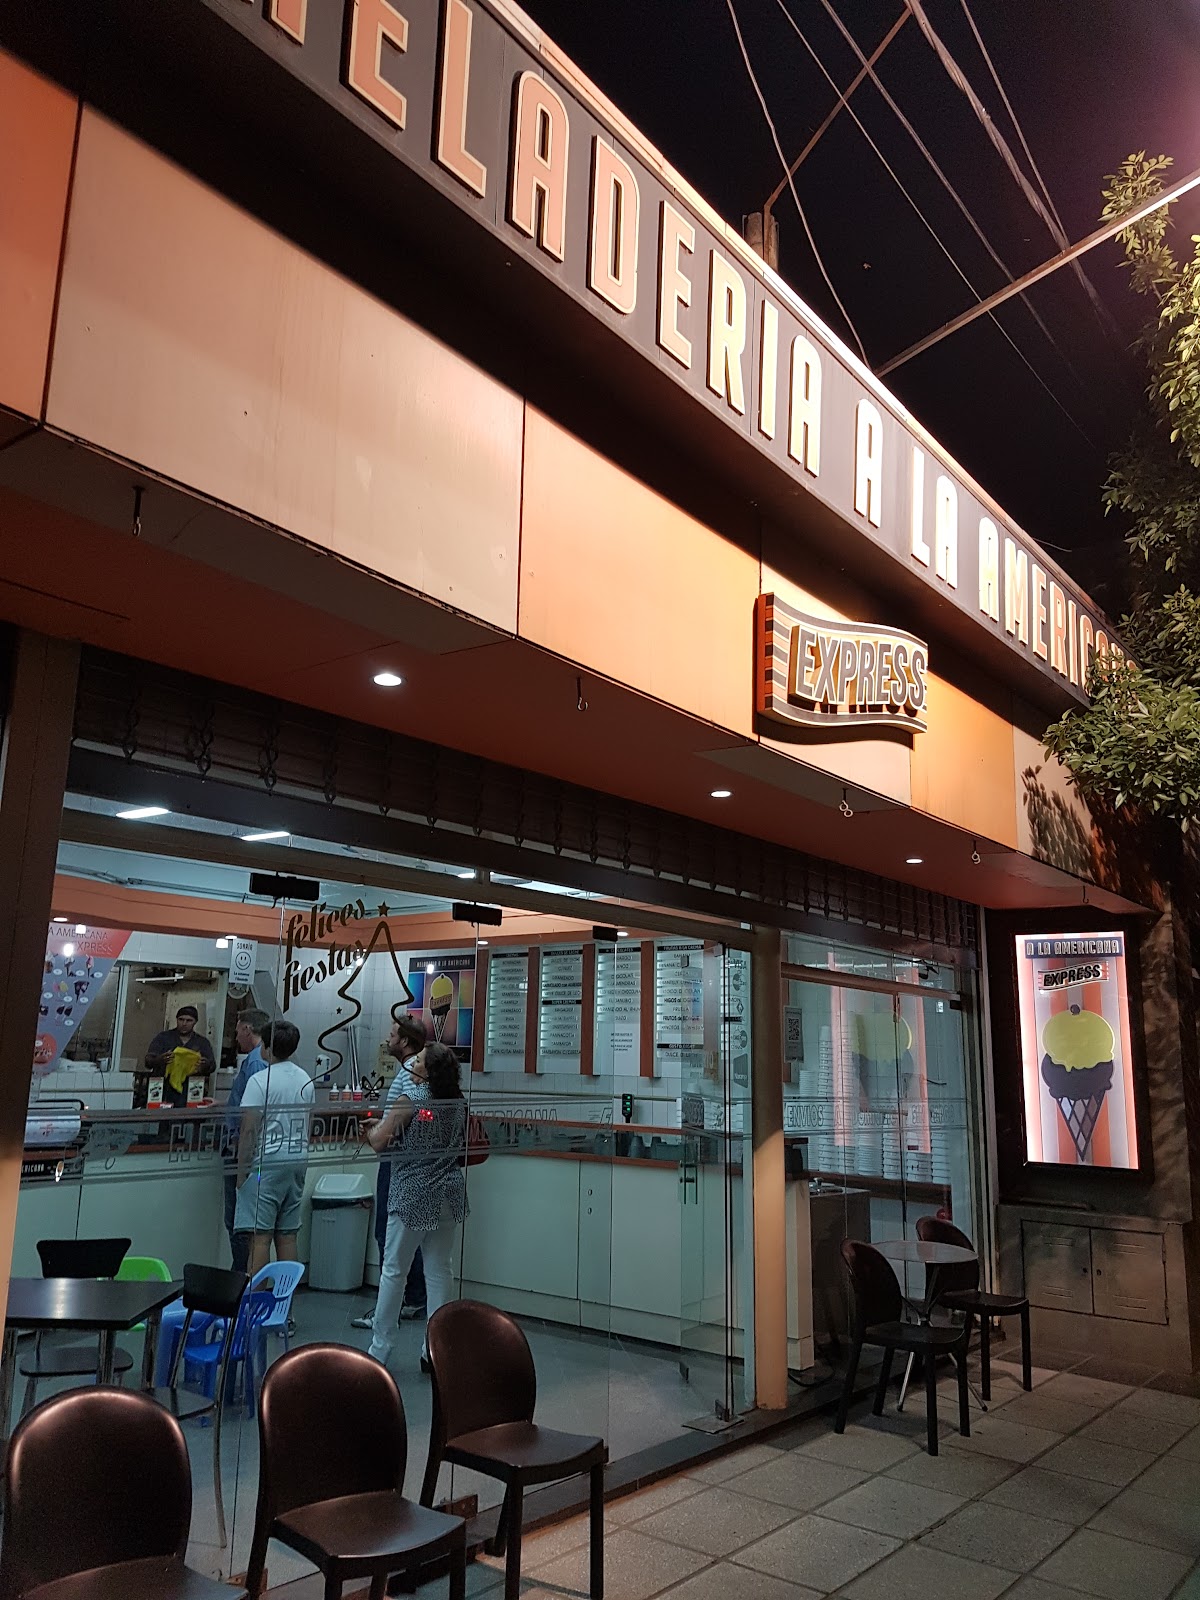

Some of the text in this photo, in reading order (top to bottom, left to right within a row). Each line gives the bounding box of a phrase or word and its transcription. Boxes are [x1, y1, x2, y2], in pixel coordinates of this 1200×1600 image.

[243, 0, 1137, 700] ELADERIA A LA AMERIC
[794, 625, 928, 709] EXPRESS
[76, 941, 113, 955] XPRESS
[286, 899, 365, 965] felices
[1026, 939, 1120, 956] A LA AMERICANA
[283, 940, 364, 1014] fiestas
[1043, 964, 1101, 987] EXPRESS
[168, 1115, 361, 1163] HELDERIA
